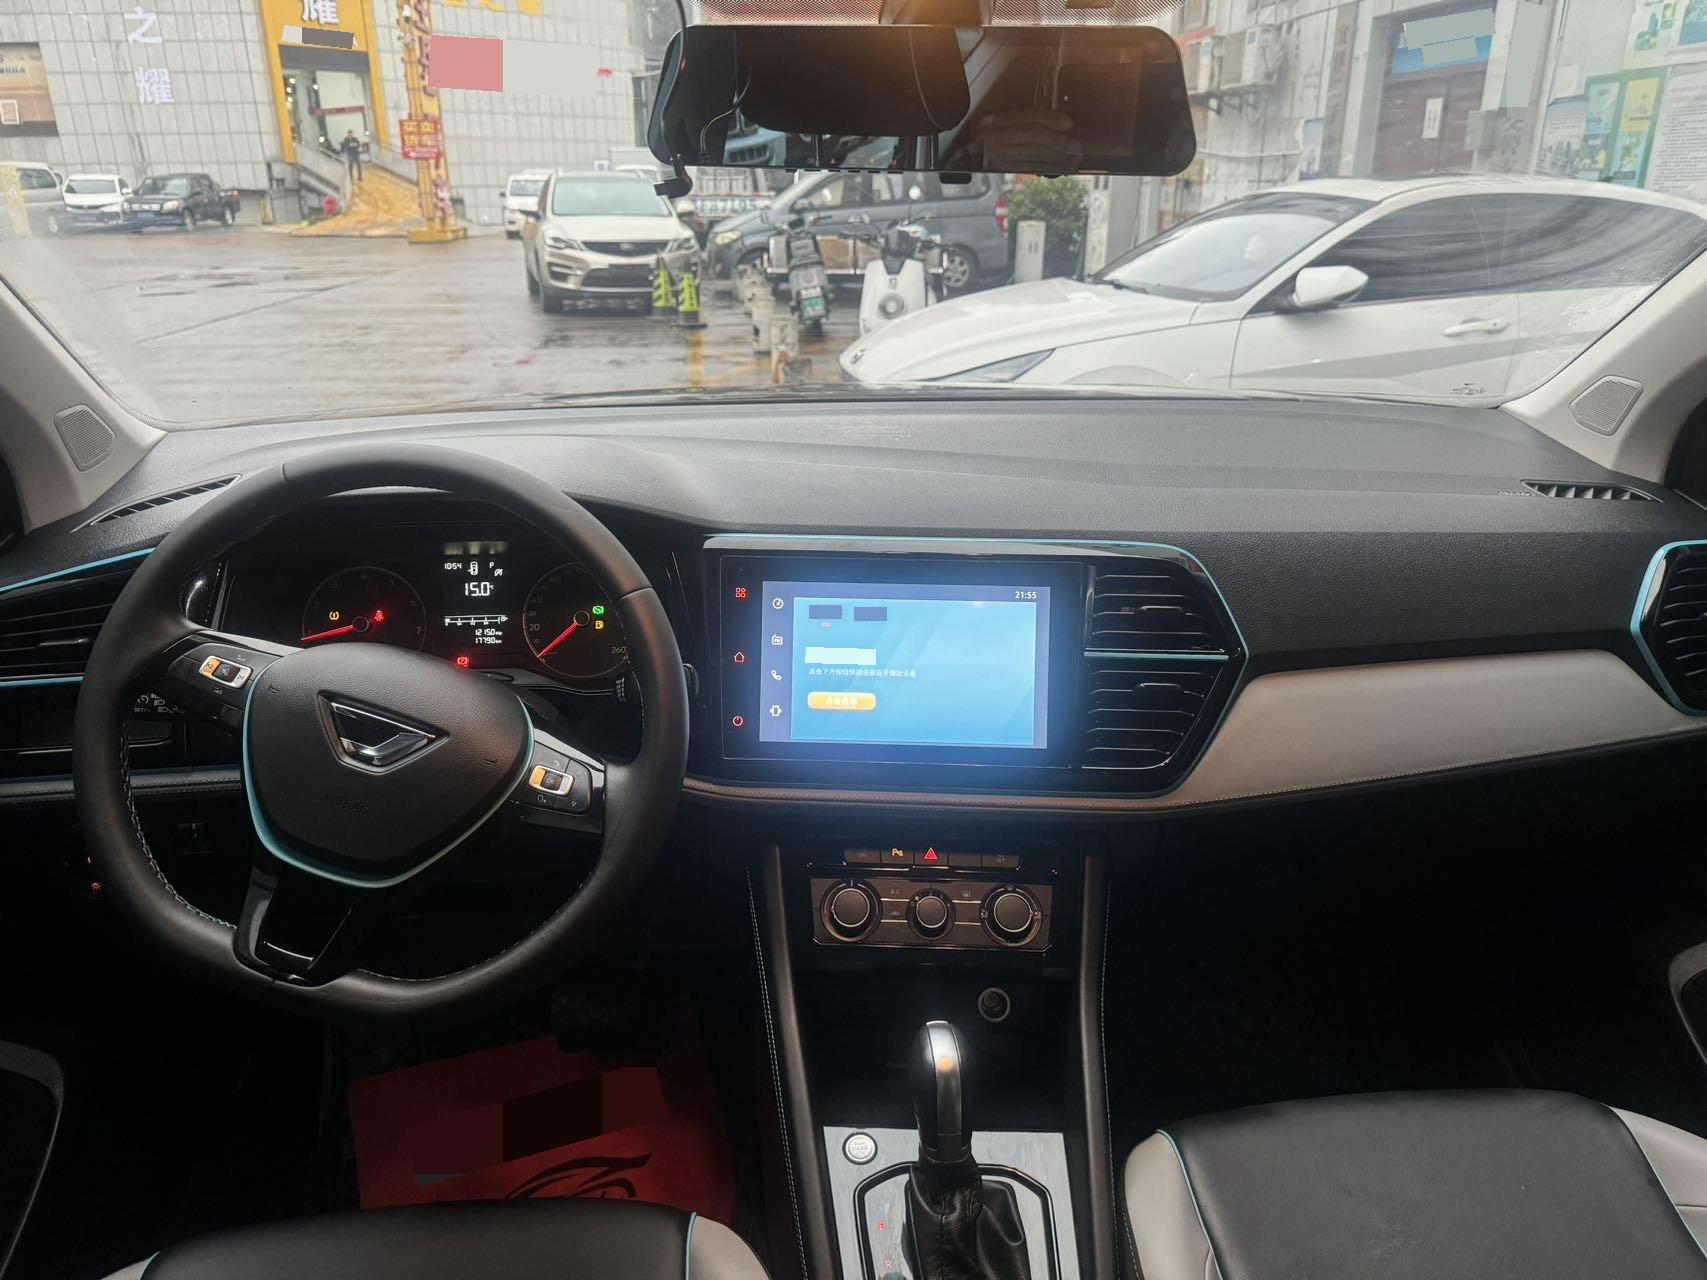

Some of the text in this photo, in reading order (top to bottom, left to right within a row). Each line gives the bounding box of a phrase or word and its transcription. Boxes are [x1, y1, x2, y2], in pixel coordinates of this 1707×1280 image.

[1015, 591, 1037, 599] 21:55
[528, 623, 540, 631] 20
[611, 646, 627, 654] 260
[885, 1259, 892, 1269] R
